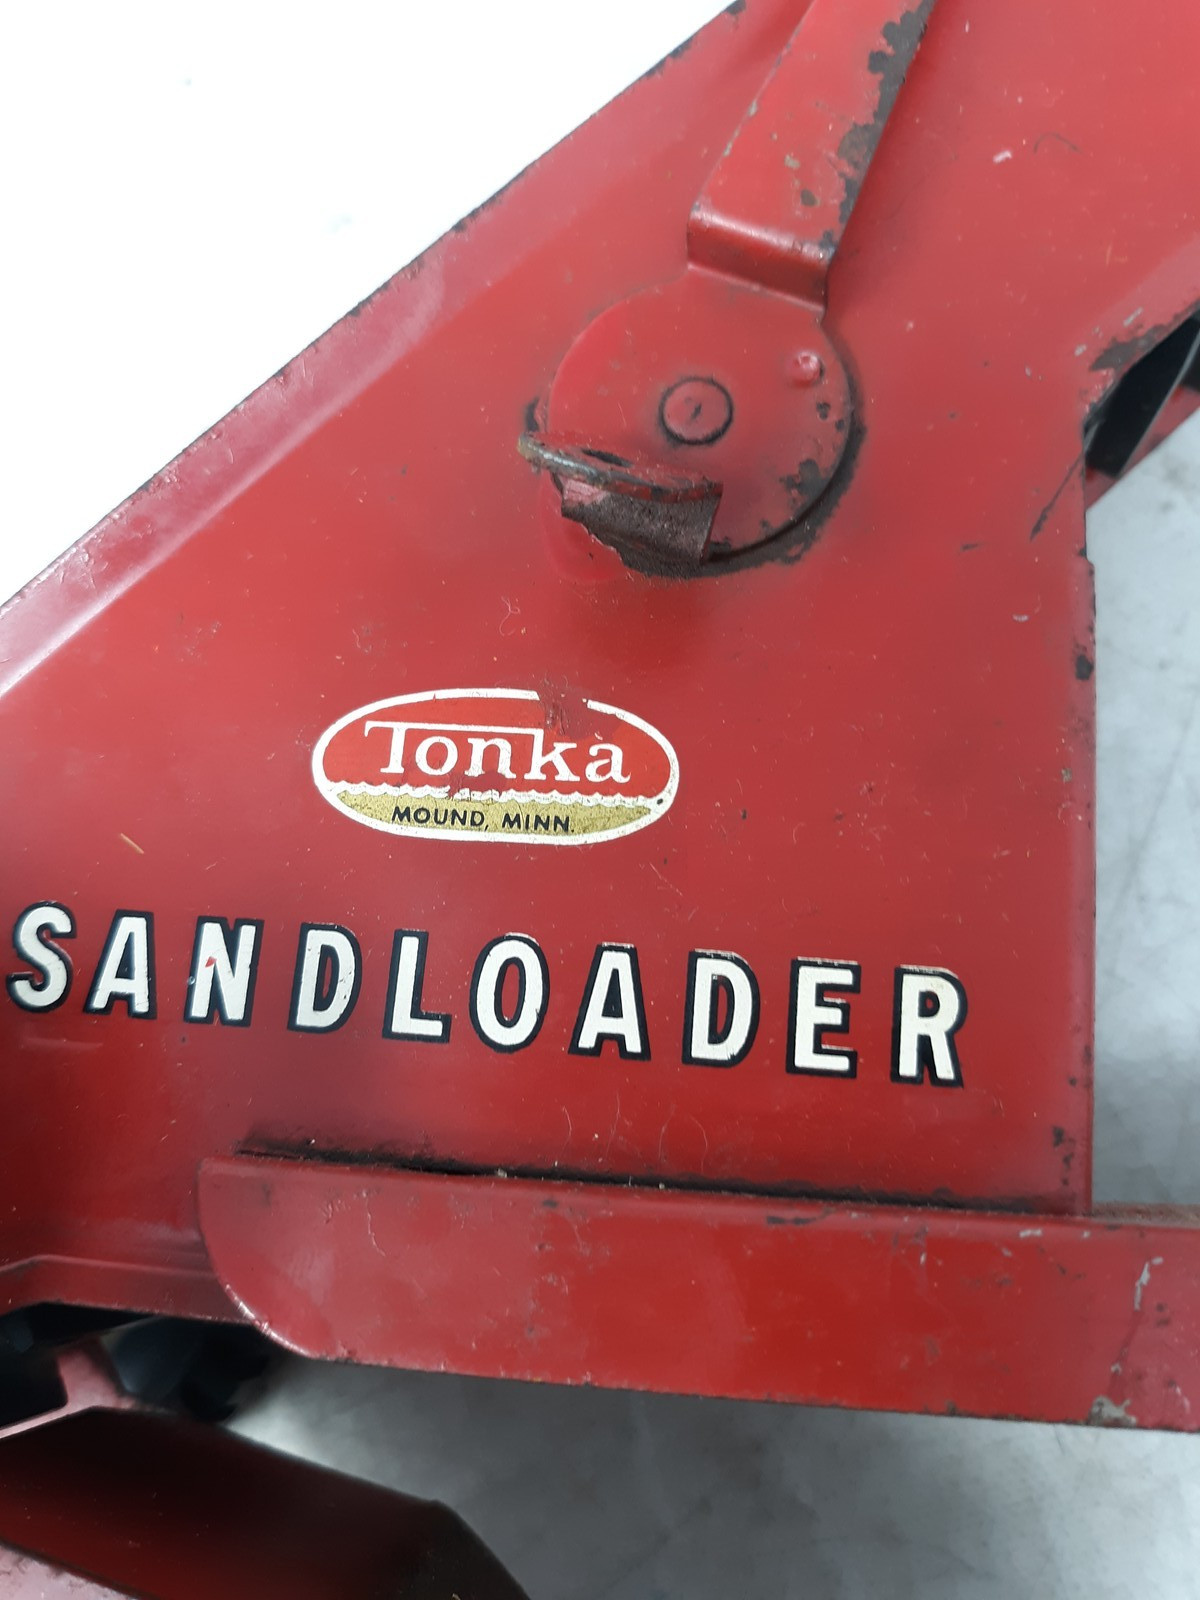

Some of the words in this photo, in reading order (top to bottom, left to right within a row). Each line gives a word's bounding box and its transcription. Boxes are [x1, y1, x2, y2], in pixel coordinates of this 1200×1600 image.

[364, 720, 631, 784] Tonka
[391, 806, 490, 831] MOUND,
[501, 813, 575, 834] MINN.
[7, 900, 967, 1088] SANDLOADER
